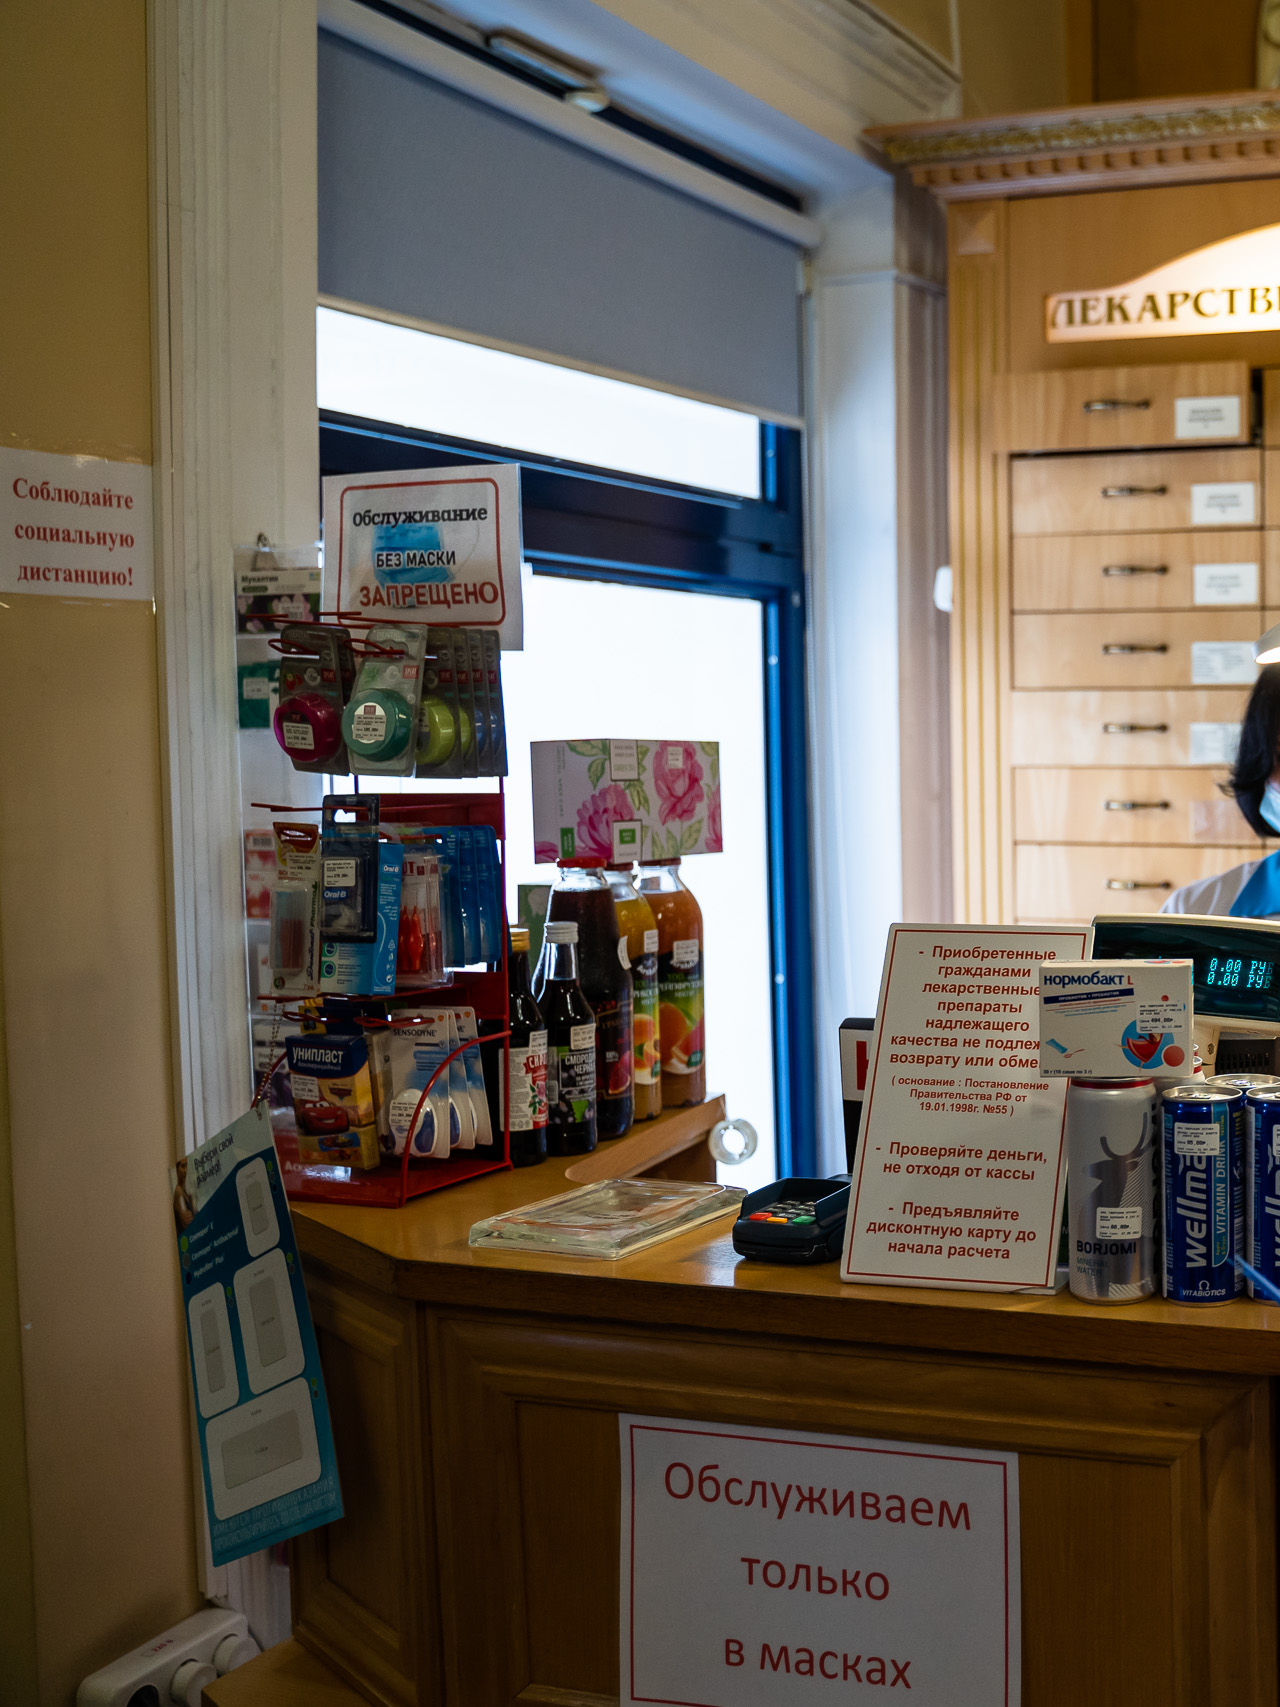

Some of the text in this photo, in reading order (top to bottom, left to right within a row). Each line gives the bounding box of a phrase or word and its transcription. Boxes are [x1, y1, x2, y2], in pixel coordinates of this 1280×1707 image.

[12, 477, 134, 511] Соблюдайте
[352, 505, 488, 528] Обслуживание
[14, 521, 135, 549] социальную
[376, 550, 456, 568] БЕЗ МАСКИ
[17, 562, 133, 587] дистанцию!
[359, 580, 499, 608] ЗАПРЕЩЕНО
[932, 945, 1056, 962] Приобретенные
[937, 964, 1032, 979] гражданами
[1209, 958, 1242, 974] 0.00
[1043, 970, 1134, 988] нормобакт L
[1207, 972, 1239, 988] 0.00
[922, 981, 1040, 998] лекарственные
[937, 1000, 1022, 1016] препараты
[393, 1028, 438, 1037] SENSODYNE
[925, 1018, 1030, 1033] надлежащего
[890, 1035, 1040, 1052] качества не подлеж
[889, 1053, 1040, 1069] возврату или обме
[898, 1077, 955, 1089] основание
[965, 1078, 1049, 1091] Постановление
[910, 1088, 1027, 1103] Правительства РФ от
[919, 1101, 980, 1114] 19.01.1998г.
[983, 1103, 1008, 1115] №55
[194, 1134, 234, 1170] Выбери свой
[889, 1141, 983, 1161] Проверяйте
[987, 1148, 1048, 1165] деньги,
[196, 1162, 221, 1187] размер!
[883, 1162, 1035, 1181] не отходя от кассы
[902, 1201, 1020, 1221] Предъявляйте
[1177, 1155, 1207, 1268] wellma
[1216, 1183, 1226, 1234] VITAMIN
[866, 1220, 1037, 1243] дисконтную карту до
[888, 1241, 1011, 1261] начала расчета
[1076, 1240, 1137, 1256] BORJOMI
[1182, 1288, 1226, 1297] VITABIOTICS
[664, 1461, 972, 1531] Обслуживаем
[740, 1557, 890, 1600] только
[724, 1638, 912, 1689] в масках
